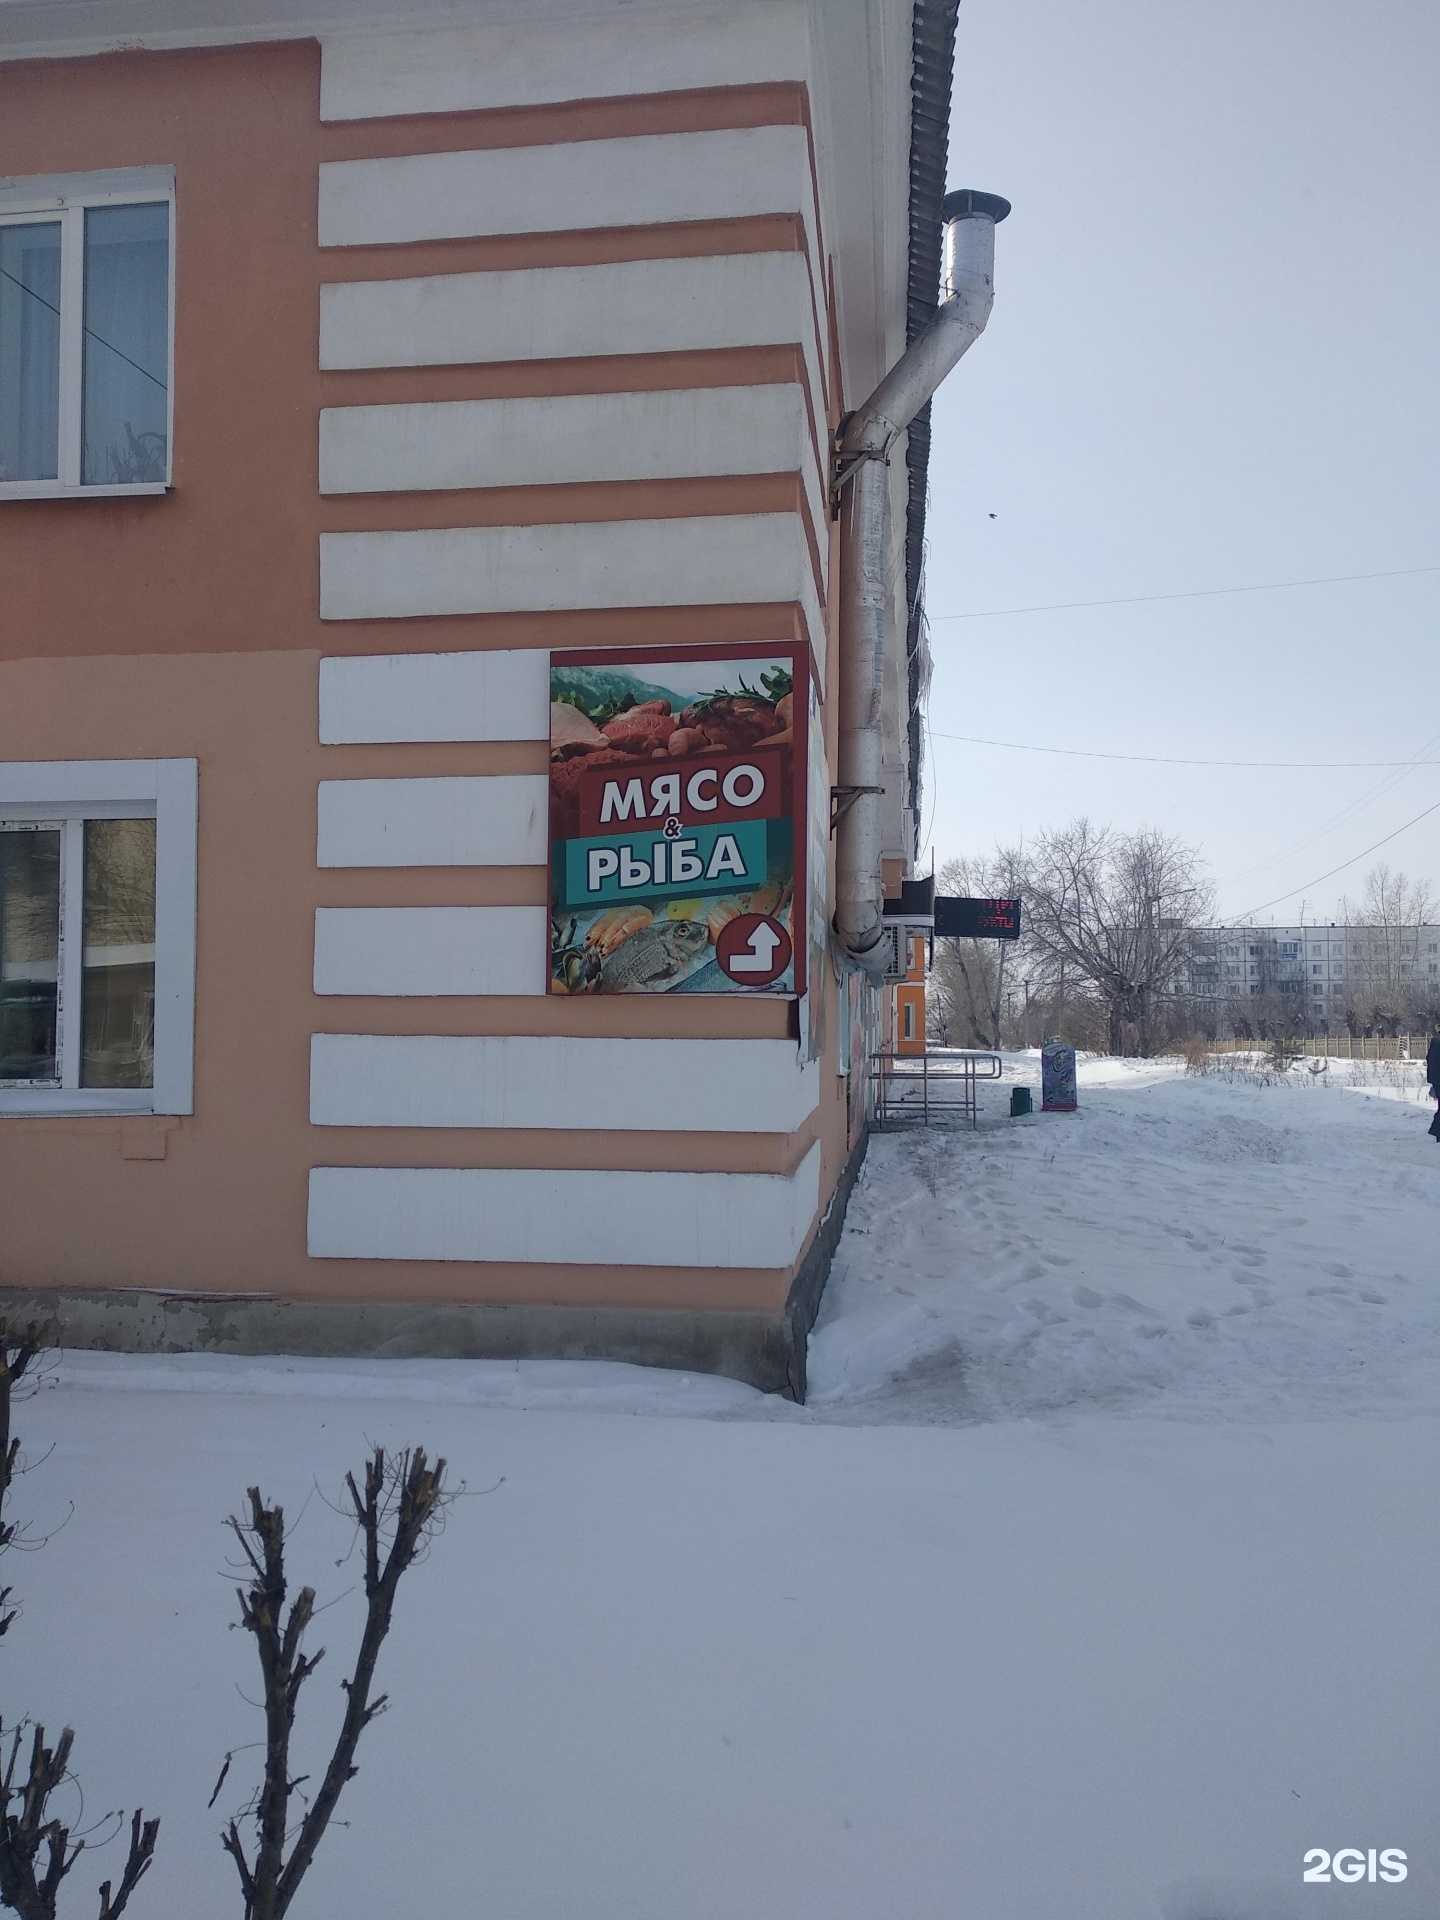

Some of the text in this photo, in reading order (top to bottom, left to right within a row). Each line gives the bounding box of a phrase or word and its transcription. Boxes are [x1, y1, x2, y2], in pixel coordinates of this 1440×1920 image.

[600, 764, 766, 823] МЯСО
[663, 817, 683, 839] &
[587, 835, 747, 891] РЫБА
